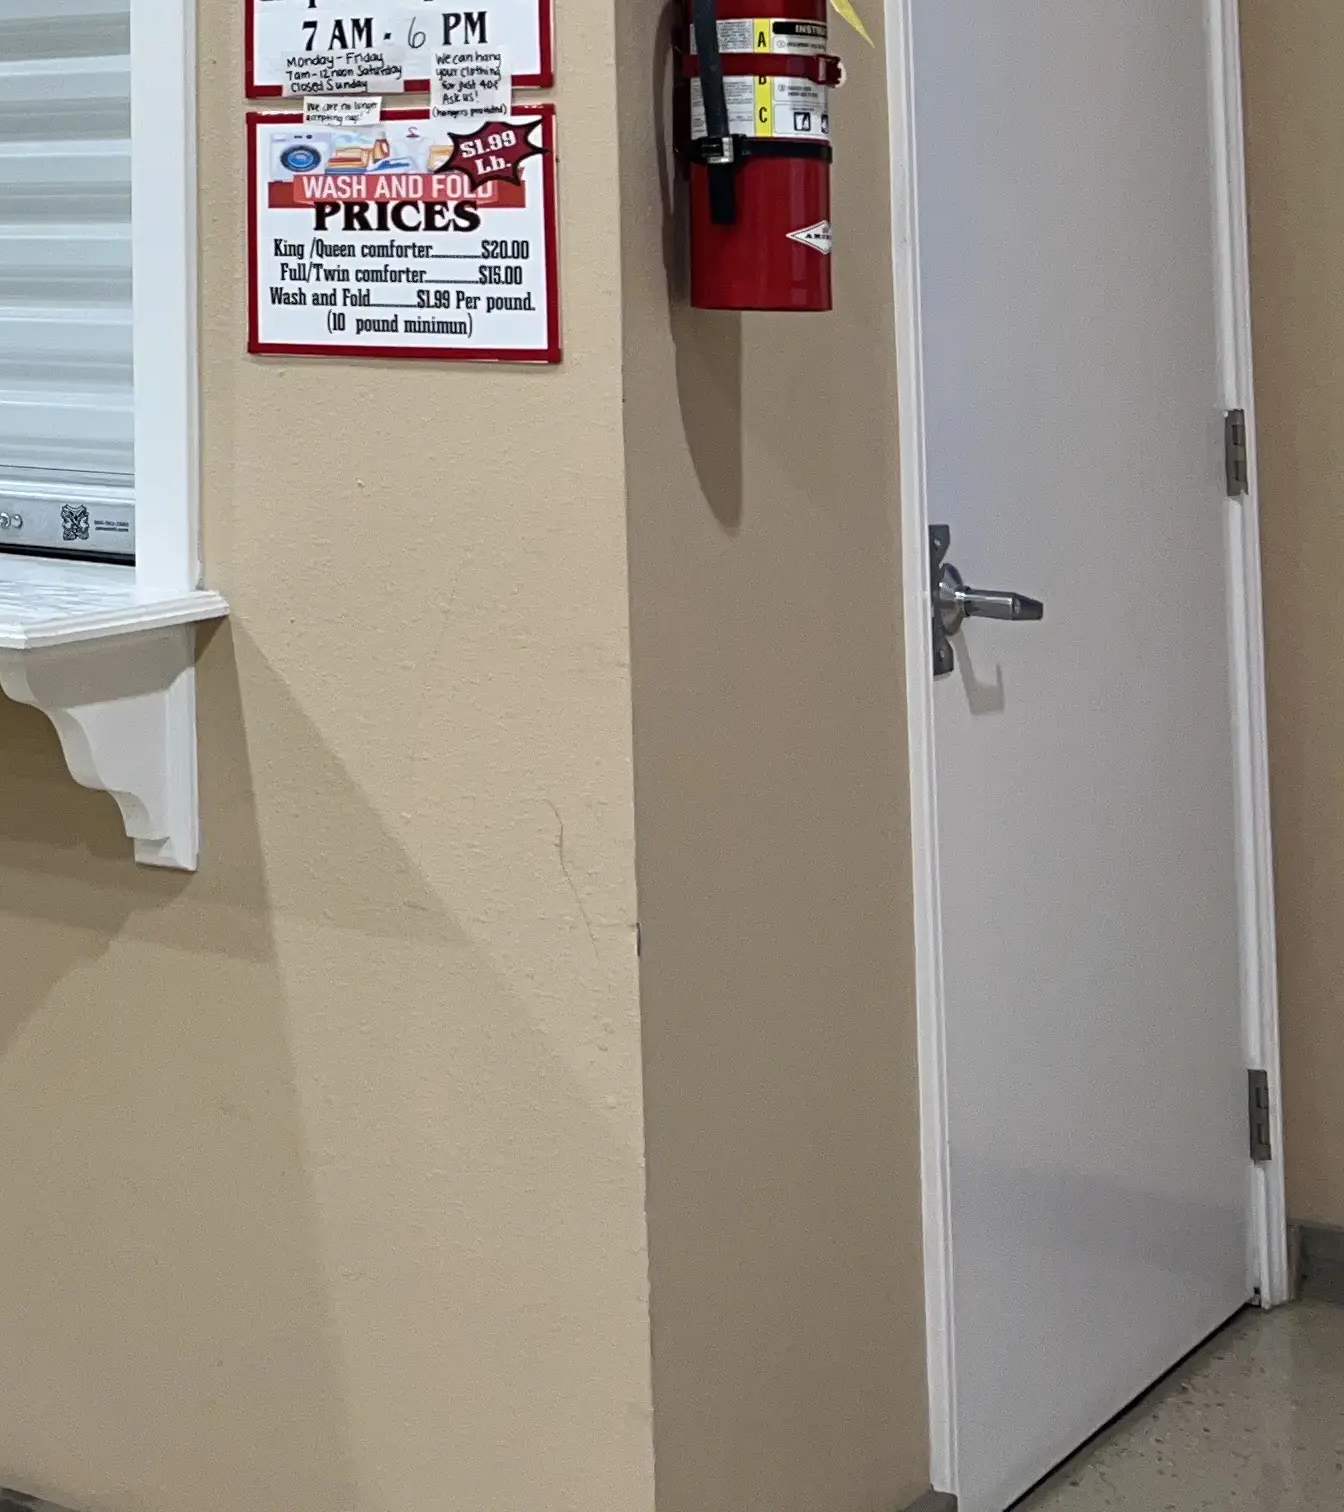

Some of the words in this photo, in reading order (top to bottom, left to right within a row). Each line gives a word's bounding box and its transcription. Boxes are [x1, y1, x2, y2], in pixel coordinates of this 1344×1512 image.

[301, 20, 319, 51] 7
[328, 17, 373, 51] AM
[407, 17, 427, 49] 6
[442, 11, 488, 45] PM
[757, 31, 767, 48] A
[286, 55, 334, 69] Monday
[345, 52, 385, 69] Friday
[435, 53, 451, 65] We
[452, 53, 473, 65] can
[475, 51, 502, 68] hang
[326, 78, 368, 92] Sunday
[758, 106, 768, 124] C
[459, 130, 517, 158] $1.99
[475, 155, 512, 175] Lb.
[302, 176, 367, 198] WASH
[375, 176, 423, 198] AND
[432, 175, 493, 198] FOLD
[313, 200, 481, 232] PRICES
[273, 239, 304, 259] King
[481, 240, 530, 260] $20.00
[280, 262, 350, 283] Full/Twin
[478, 265, 523, 285] $15.00
[270, 287, 307, 306] Wash
[312, 289, 337, 306] and
[456, 290, 481, 310] Per
[486, 292, 536, 313] pound.
[327, 309, 346, 334] (10
[356, 314, 399, 335] pound
